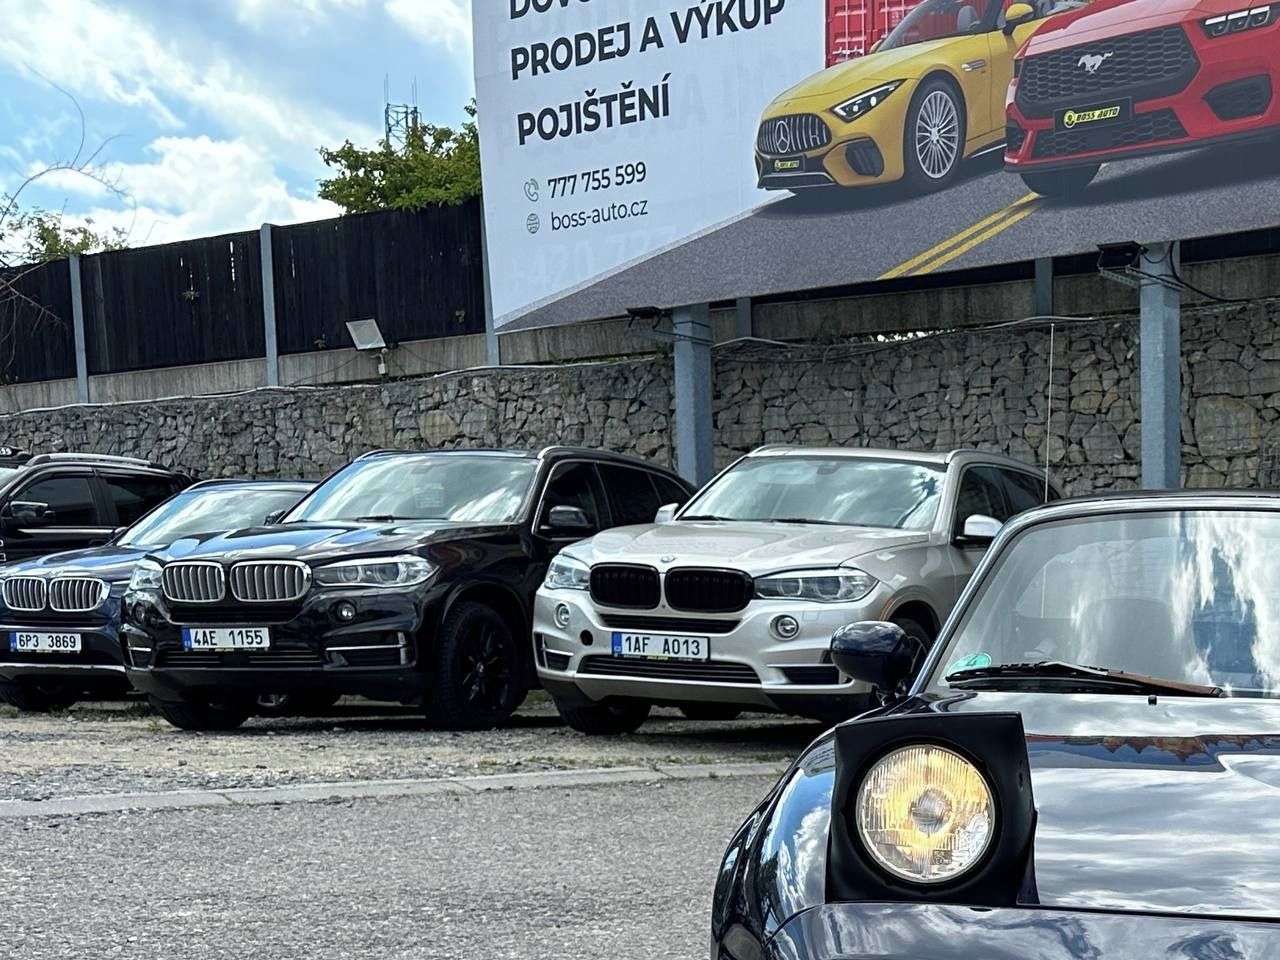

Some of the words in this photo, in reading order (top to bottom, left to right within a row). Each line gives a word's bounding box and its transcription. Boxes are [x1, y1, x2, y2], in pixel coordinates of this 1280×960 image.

[511, 22, 630, 80] PRODEJ
[640, 16, 664, 52] A
[517, 72, 672, 146] POJIŠTĚNÍ
[548, 174, 577, 199] 777
[581, 168, 611, 192] 755
[615, 161, 647, 186] 599
[551, 200, 648, 231] boss-auto.cz
[18, 634, 39, 648] 6P3
[47, 635, 76, 648] 3869
[194, 630, 217, 646] 4AE
[228, 630, 263, 646] 1155
[625, 636, 650, 653] 1AF
